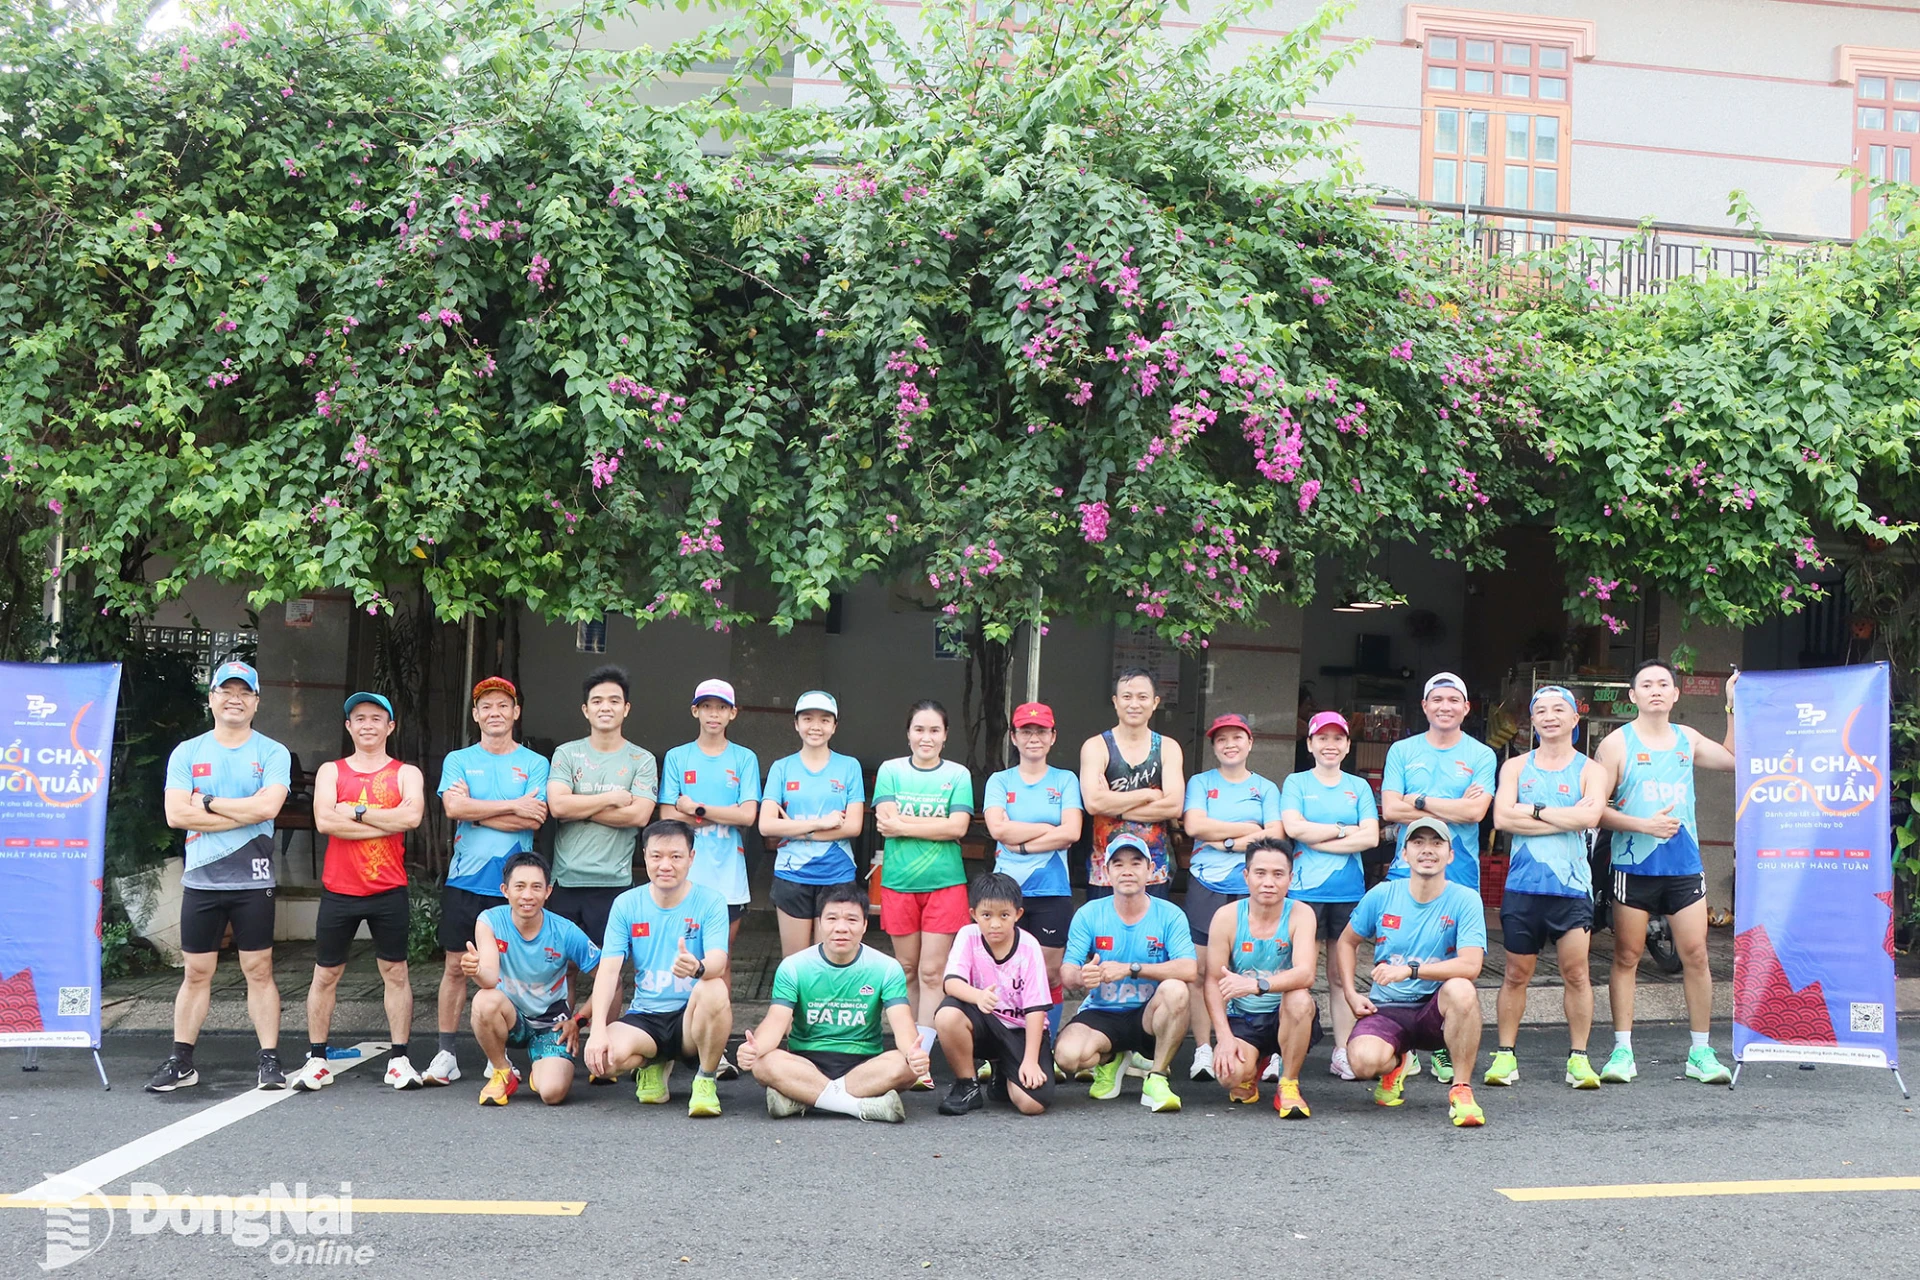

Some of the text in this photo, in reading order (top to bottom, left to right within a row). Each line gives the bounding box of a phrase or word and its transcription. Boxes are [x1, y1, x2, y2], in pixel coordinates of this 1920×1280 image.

[1750, 748, 1877, 777] BUỔI CHẠY
[41, 770, 97, 793] TUẦN
[1642, 779, 1688, 804] BPR
[1750, 776, 1875, 803] CUỐI TUẦN
[252, 859, 270, 880] 93
[807, 1008, 867, 1026] BÀ RÁ
